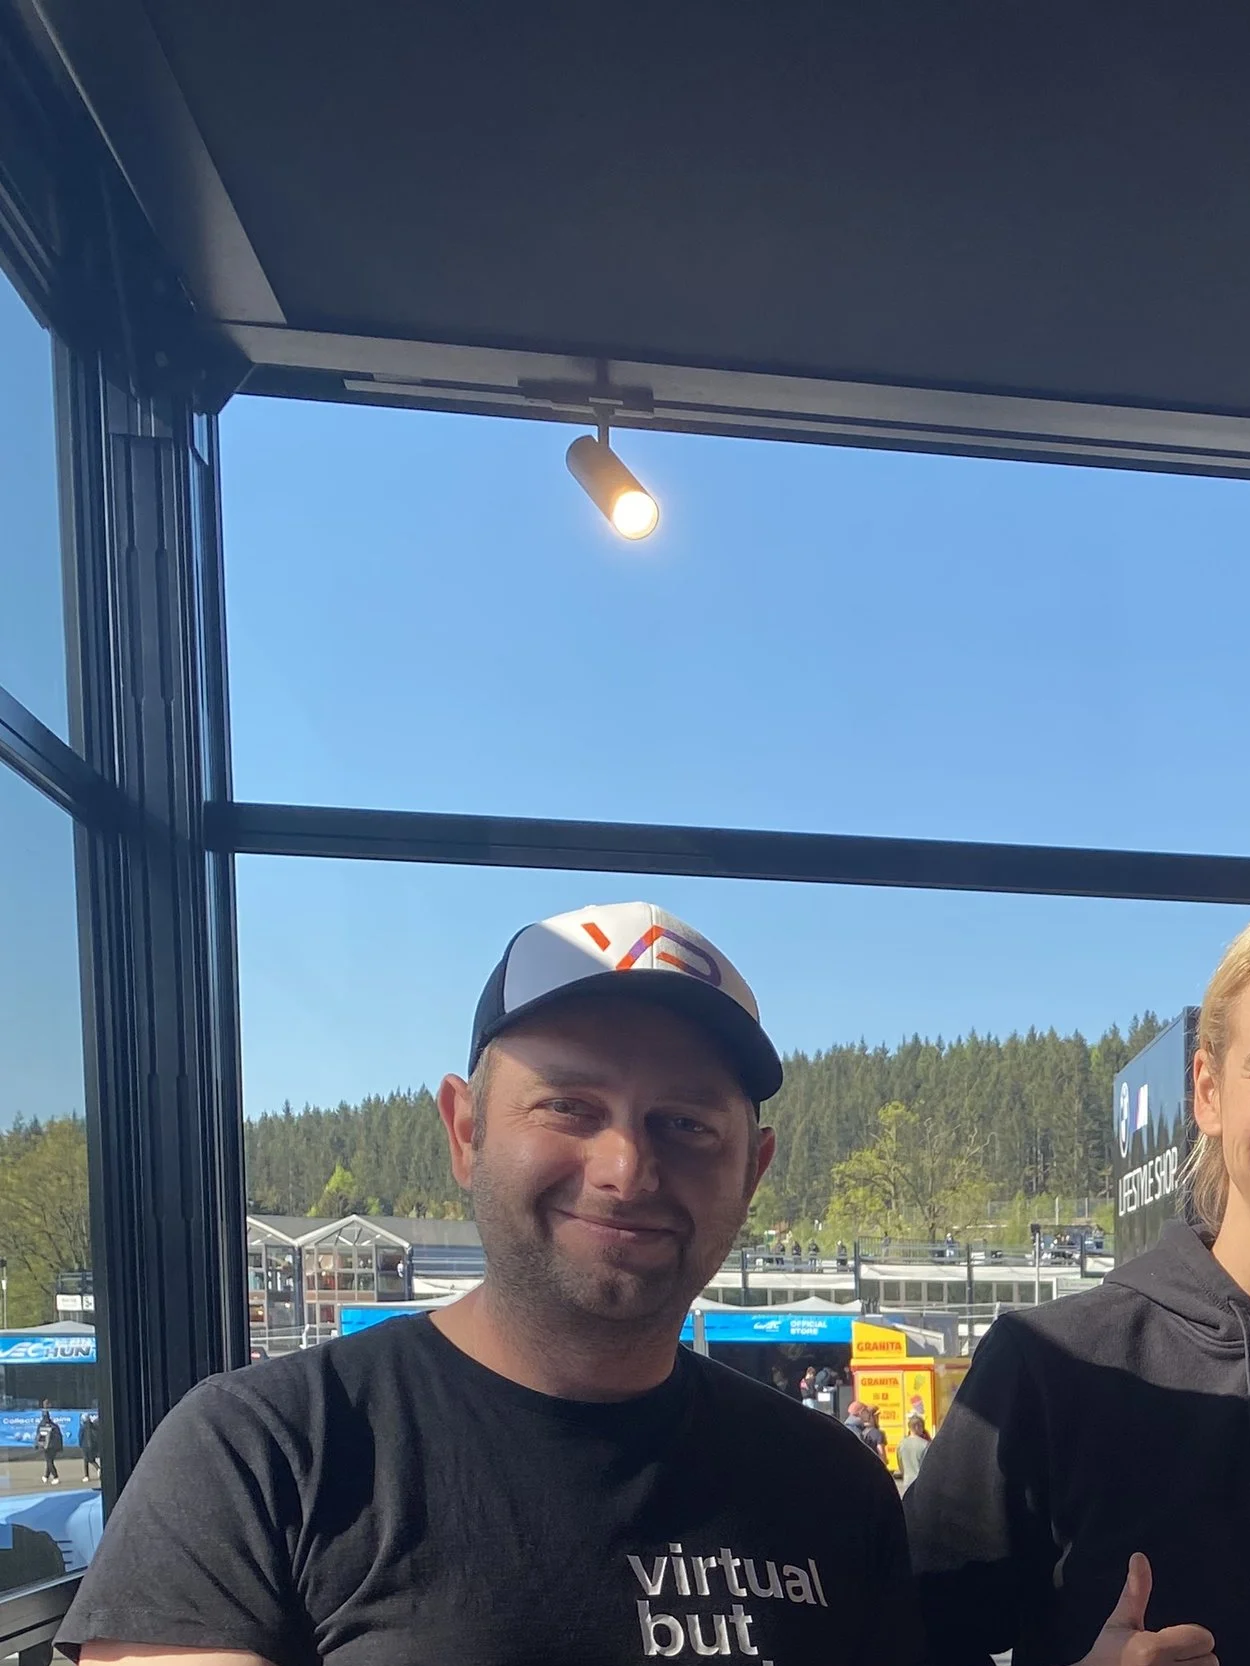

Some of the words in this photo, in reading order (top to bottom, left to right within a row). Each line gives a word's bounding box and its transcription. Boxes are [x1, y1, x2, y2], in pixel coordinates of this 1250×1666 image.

[1119, 1160, 1154, 1217] LIFESTYLE
[789, 1320, 828, 1328] OFFICIAL
[857, 1341, 902, 1352] GRANITA
[861, 1377, 900, 1386] GRANITA
[626, 1542, 829, 1607] virtual
[636, 1600, 759, 1657] but
